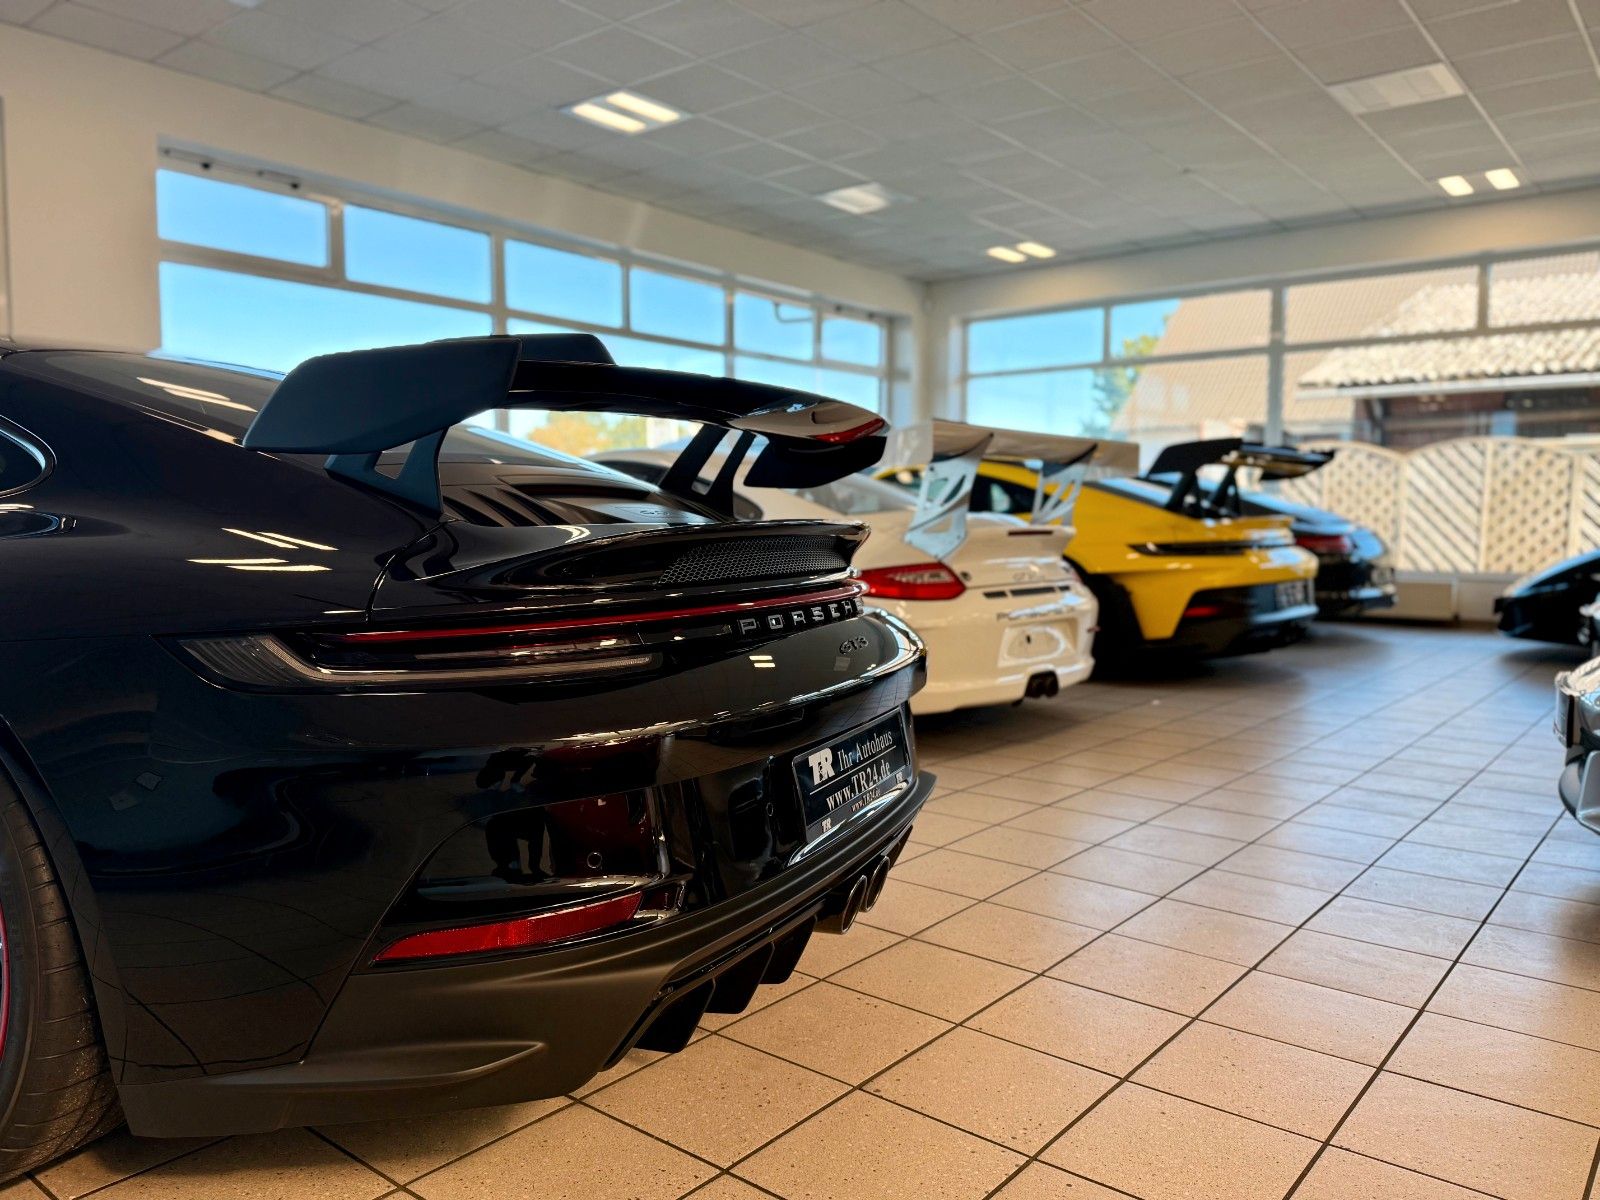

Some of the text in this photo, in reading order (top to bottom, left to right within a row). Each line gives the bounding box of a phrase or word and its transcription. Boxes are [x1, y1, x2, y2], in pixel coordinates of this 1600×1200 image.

[837, 731, 893, 772] Ihr Autohaus
[825, 759, 891, 812] www.TR24.de
